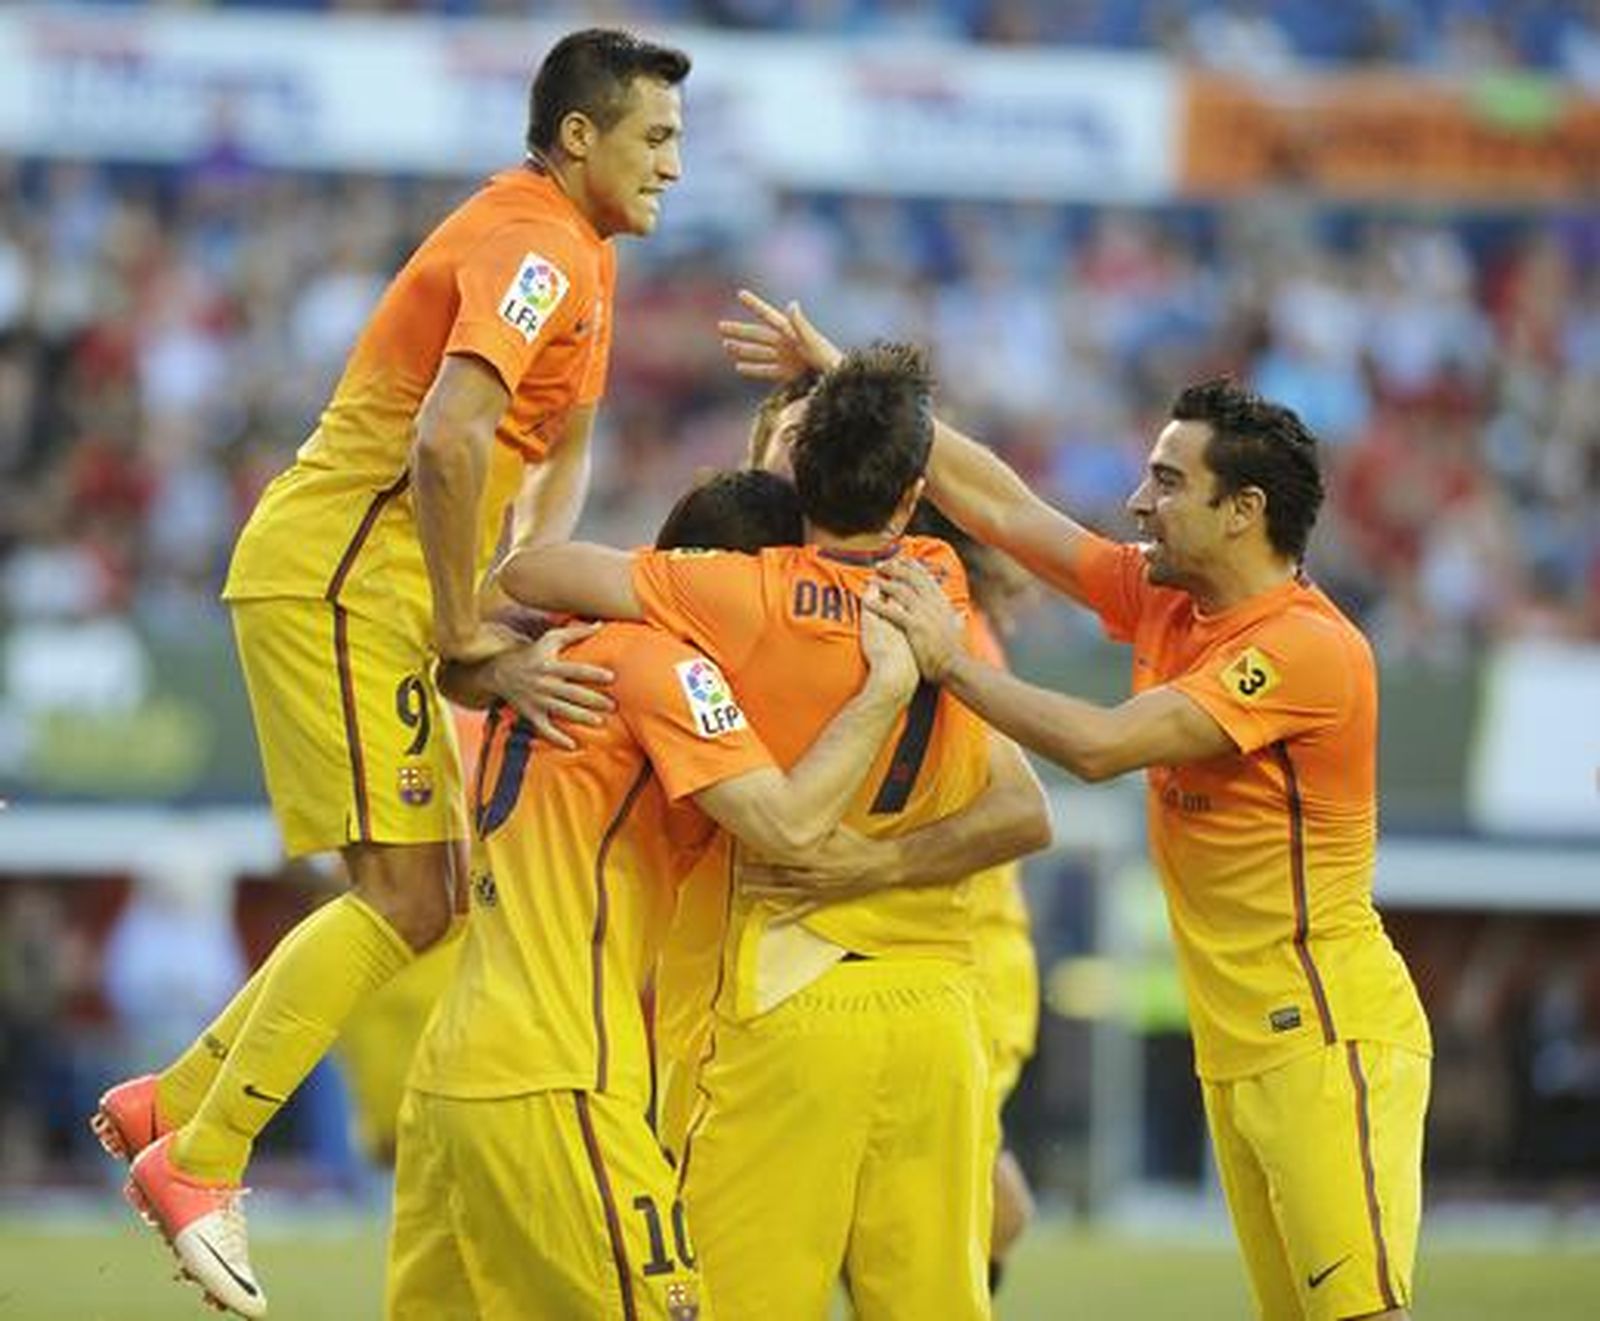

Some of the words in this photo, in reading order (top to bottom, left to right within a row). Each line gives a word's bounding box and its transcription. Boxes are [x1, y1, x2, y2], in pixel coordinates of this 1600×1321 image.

[1239, 668, 1266, 696] 3
[396, 674, 431, 756] 9
[701, 704, 739, 734] LFP
